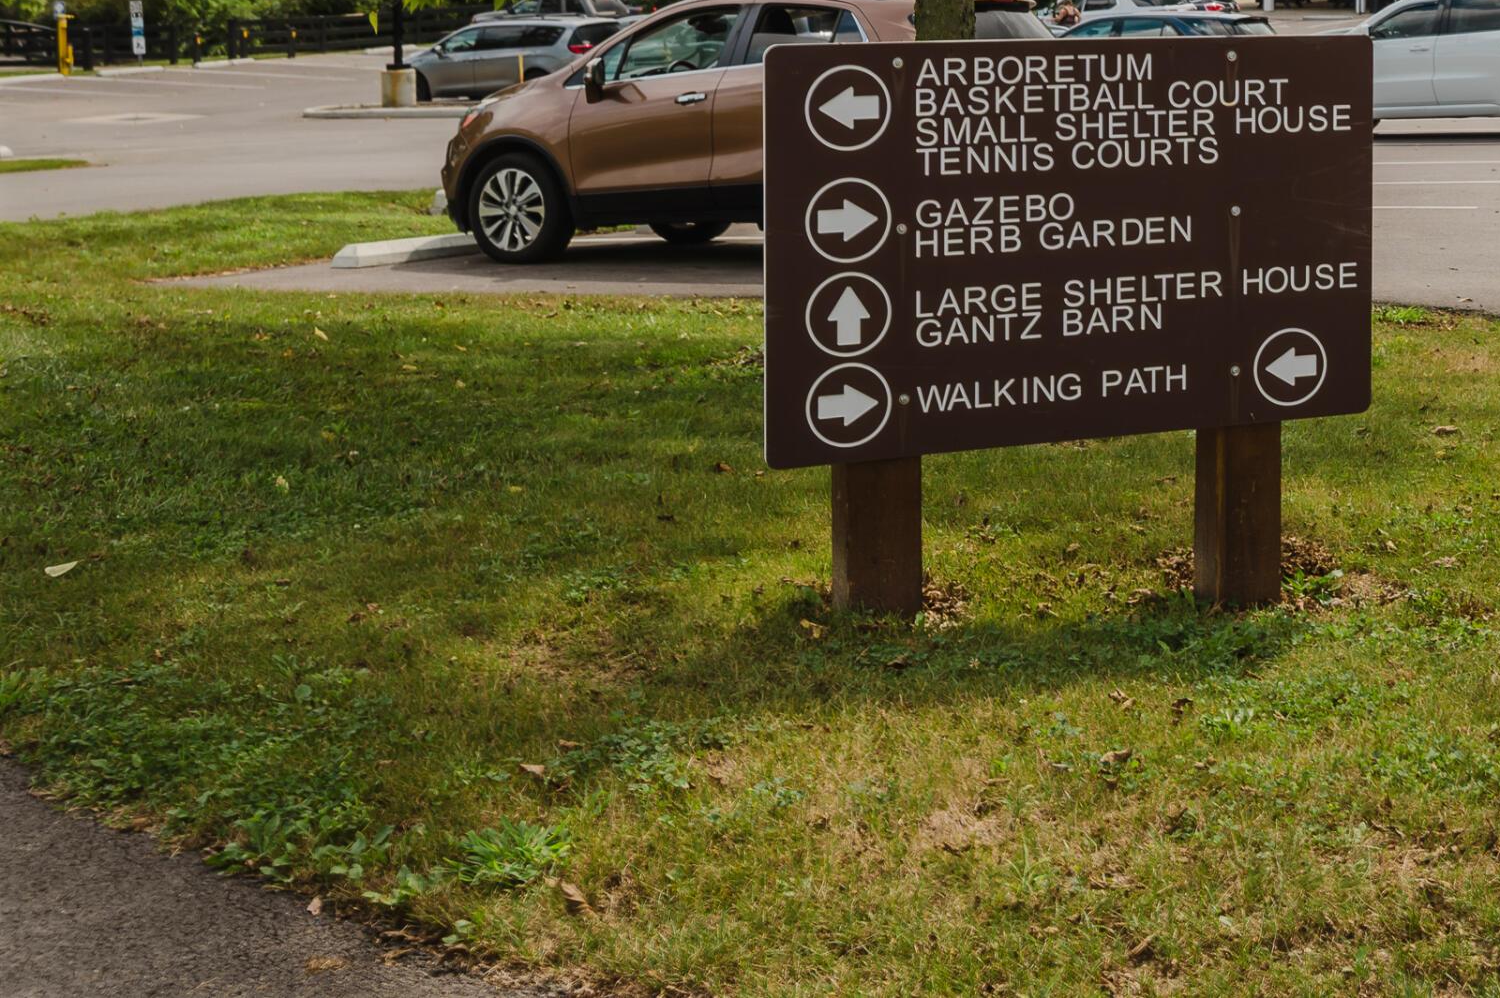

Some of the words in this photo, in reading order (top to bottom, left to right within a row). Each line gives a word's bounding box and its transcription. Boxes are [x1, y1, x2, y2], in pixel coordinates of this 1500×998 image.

[915, 53, 1152, 87] ARBORETUM
[915, 82, 1155, 117] BASKETBALL
[1168, 78, 1289, 109] COURT
[915, 114, 1038, 147] SMALL
[1055, 108, 1216, 141] SHELTER
[1235, 104, 1352, 135] HOUSE
[915, 143, 1055, 176] TENNIS
[1071, 136, 1219, 170] COURTS
[915, 192, 1075, 228] GAZEBO
[915, 222, 1022, 258] HERB
[1039, 215, 1192, 251] GARDEN
[915, 282, 1043, 318] LARGE
[1063, 271, 1223, 308] SHELTER
[1243, 262, 1358, 295] HOUSE
[915, 311, 1042, 348] GANTZ
[1062, 302, 1162, 337] BARN
[916, 373, 1082, 413] WALKING
[1102, 364, 1187, 398] PATH
